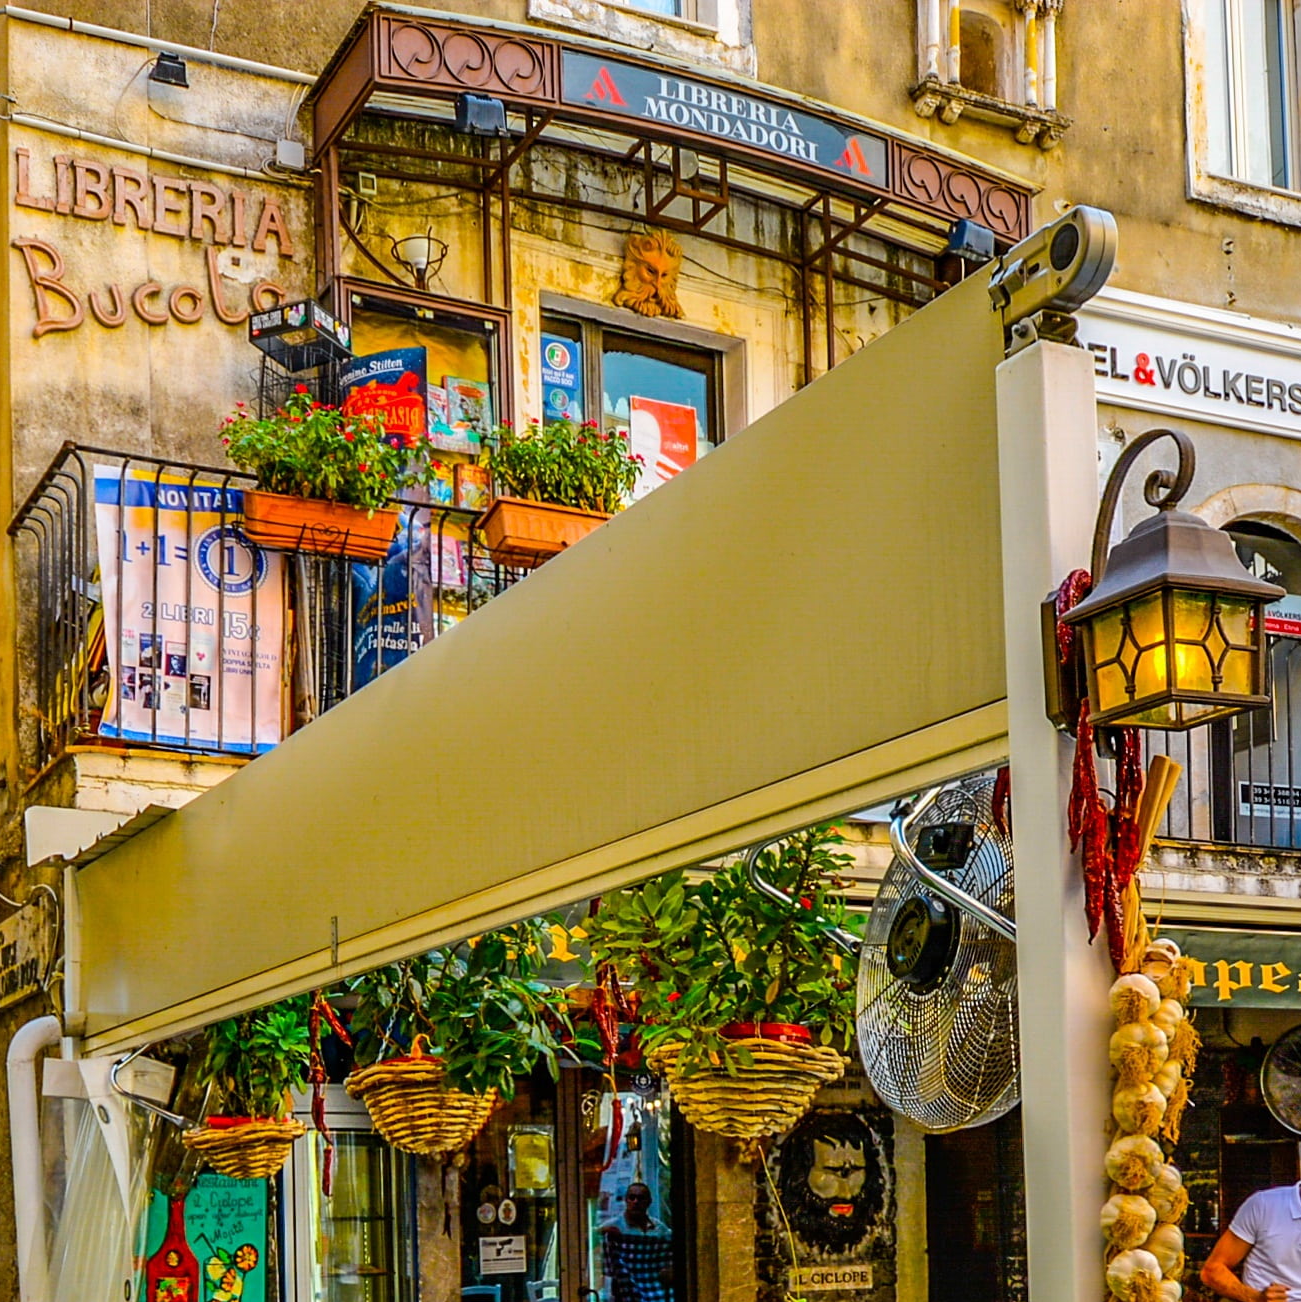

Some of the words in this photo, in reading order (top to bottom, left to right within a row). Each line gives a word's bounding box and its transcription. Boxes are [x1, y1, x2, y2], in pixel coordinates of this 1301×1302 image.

[658, 76, 804, 138] LIBRERIA
[642, 96, 821, 164] MONDADORI
[16, 147, 294, 258] LIBRERIA
[11, 236, 286, 340] Bucolo
[156, 488, 233, 509] NOVITÀ!
[141, 601, 155, 619] 2
[162, 602, 214, 626] LIBRI
[247, 661, 271, 670] SELTA
[810, 1270, 869, 1285] CICLOPE
